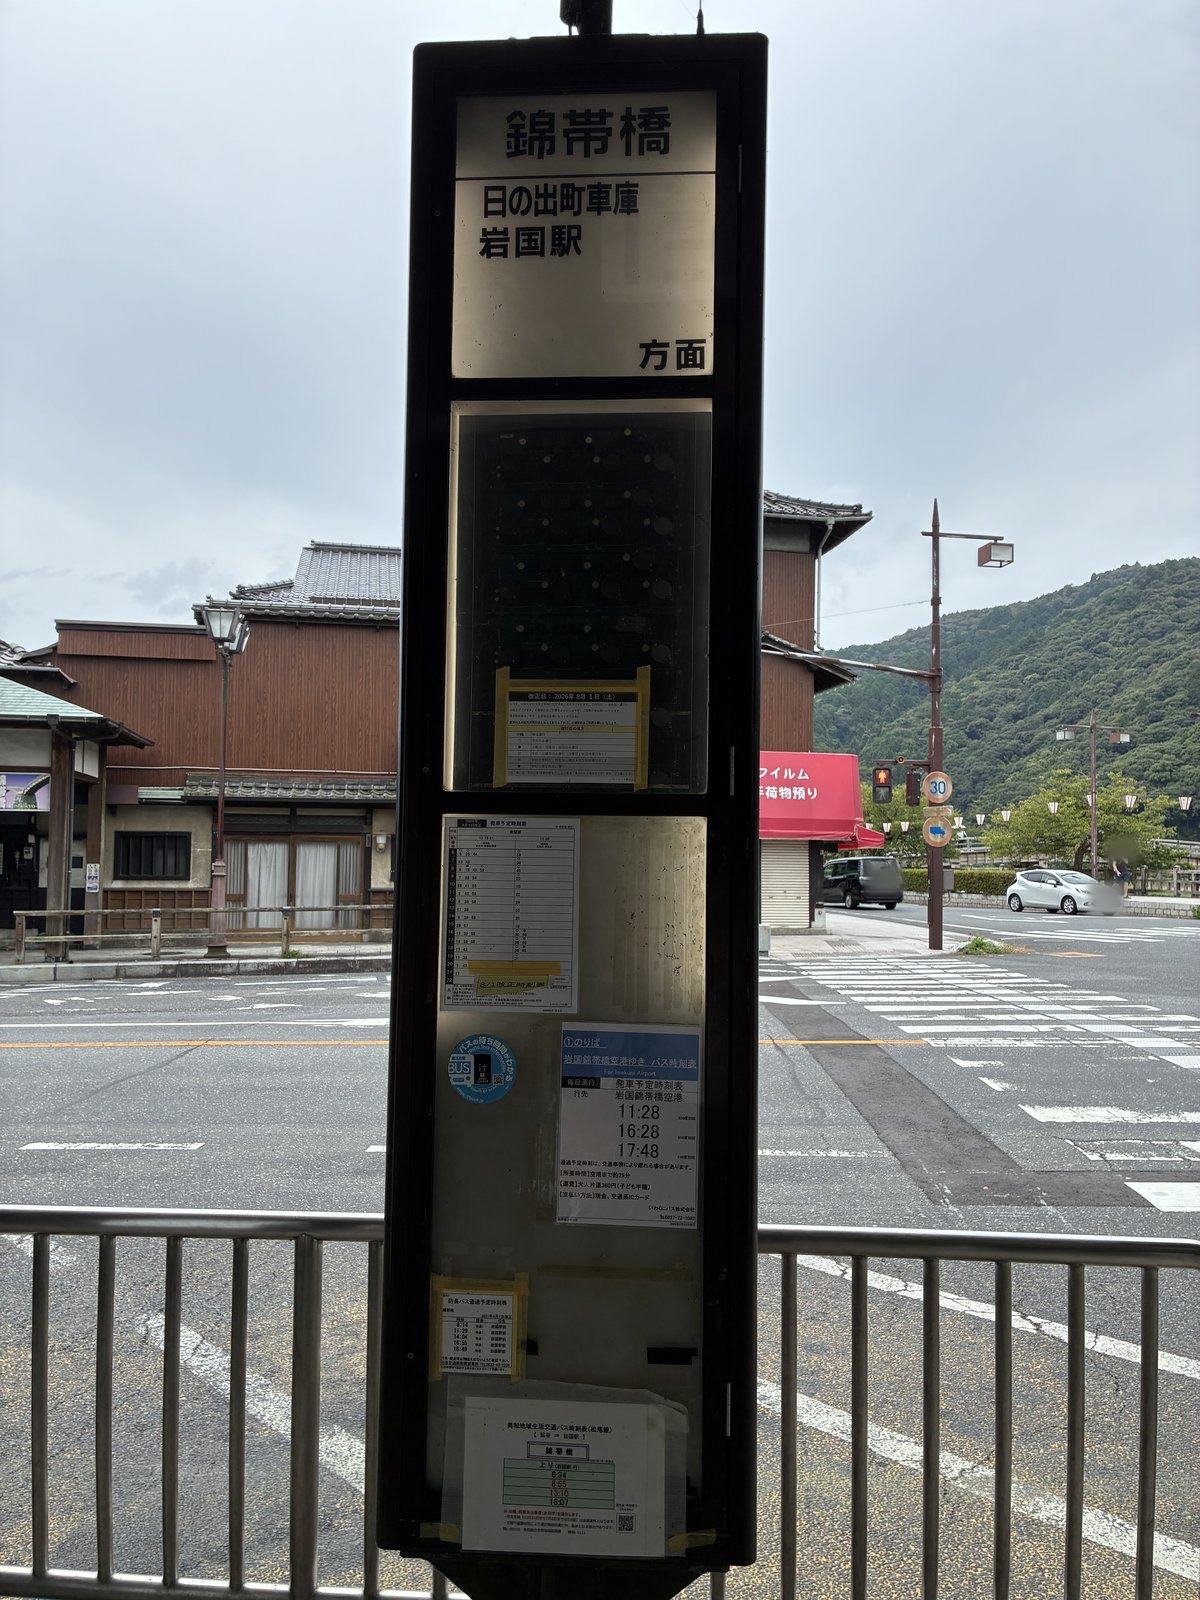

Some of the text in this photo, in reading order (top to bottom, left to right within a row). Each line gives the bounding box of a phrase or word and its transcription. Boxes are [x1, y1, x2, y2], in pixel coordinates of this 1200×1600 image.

[505, 105, 672, 160] 錦帯橋
[483, 181, 640, 219] 日の出町車庫
[478, 224, 582, 260] 岩国駅
[638, 338, 707, 371] 方面
[930, 780, 946, 795] 30
[447, 1062, 470, 1074] BUS
[651, 1058, 698, 1070] バス時刻表
[615, 1079, 683, 1091] 発車予定時刻表
[615, 1090, 683, 1103] 岩国錦帯橋空港
[618, 1103, 660, 1120] 11:28
[618, 1123, 660, 1139] 16:28
[618, 1142, 659, 1159] 17:48
